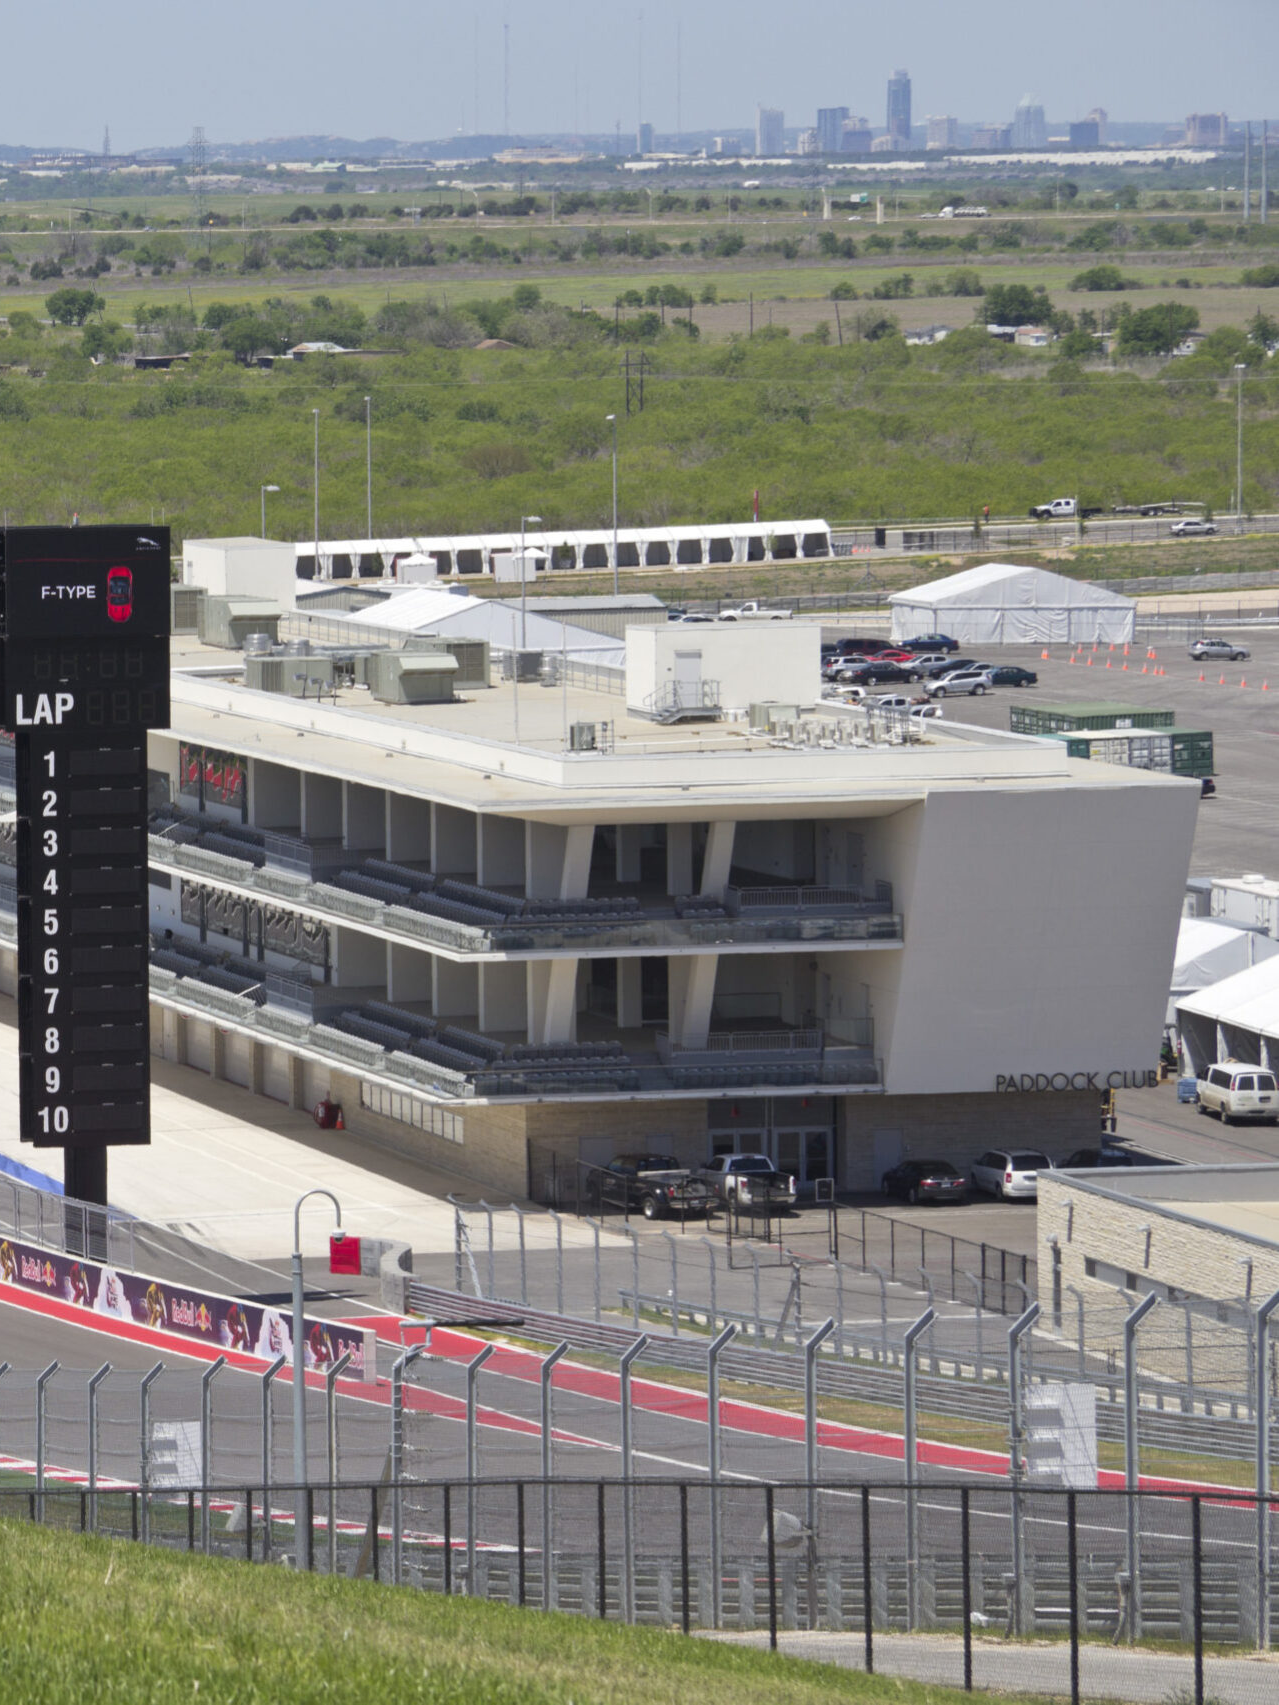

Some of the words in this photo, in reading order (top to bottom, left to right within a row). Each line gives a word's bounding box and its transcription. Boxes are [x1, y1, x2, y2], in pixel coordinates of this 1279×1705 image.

[41, 585, 97, 600] F-TYPE
[15, 693, 75, 726] LAP
[43, 750, 55, 777] 1
[42, 790, 57, 817] 2
[42, 829, 58, 857] 3
[43, 869, 59, 896] 4
[43, 908, 59, 936] 5
[43, 947, 59, 975] 6
[43, 987, 59, 1015] 7
[44, 1027, 60, 1054] 8
[45, 1066, 60, 1094] 9
[996, 1072, 1100, 1093] PADDOCK
[1106, 1069, 1159, 1089] CLUB
[37, 1105, 69, 1133] 10
